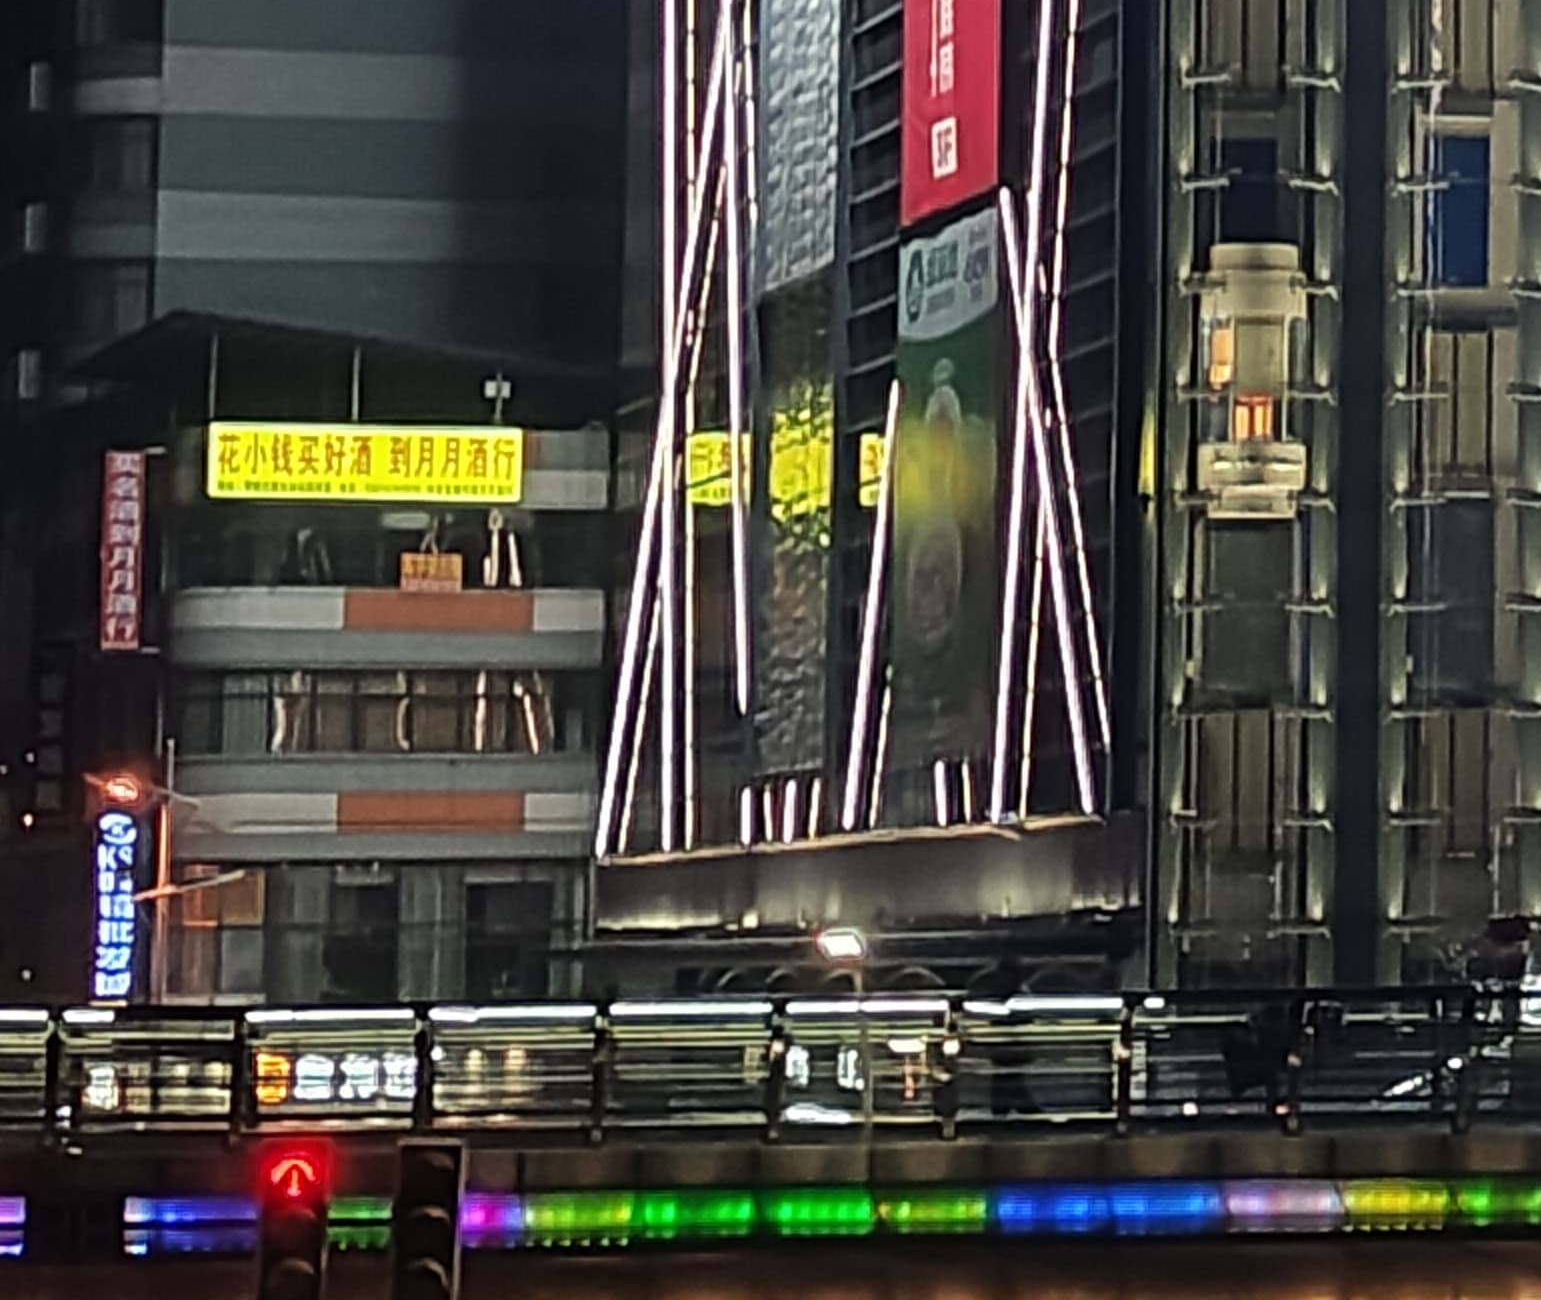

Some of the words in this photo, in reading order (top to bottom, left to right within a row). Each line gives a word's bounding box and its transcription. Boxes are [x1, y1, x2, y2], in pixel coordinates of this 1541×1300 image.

[218, 432, 373, 476] 花小钱买好酒
[389, 435, 516, 480] 到月月酒行
